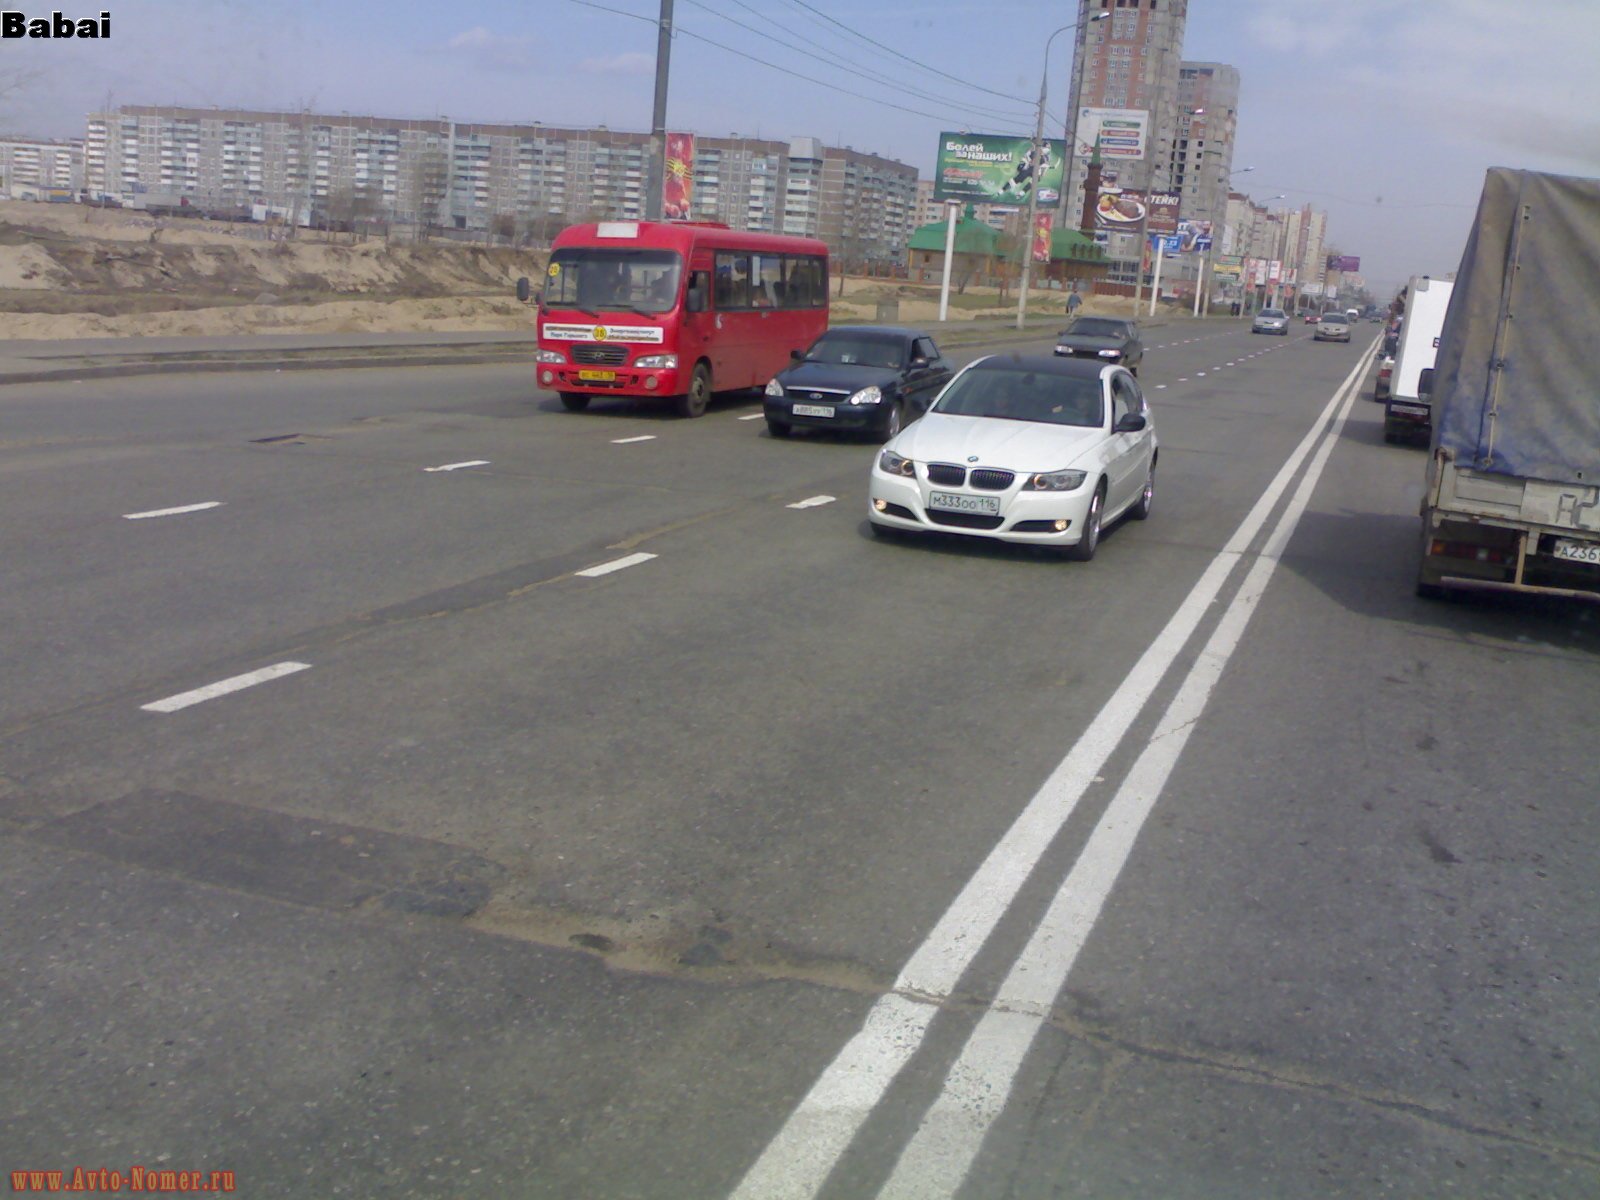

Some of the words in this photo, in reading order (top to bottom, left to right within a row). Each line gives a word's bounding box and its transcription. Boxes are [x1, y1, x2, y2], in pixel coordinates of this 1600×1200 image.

[946, 142, 984, 151] Болей
[967, 152, 1012, 161] наших!
[979, 498, 996, 509] 116
[1561, 544, 1600, 560] А236
